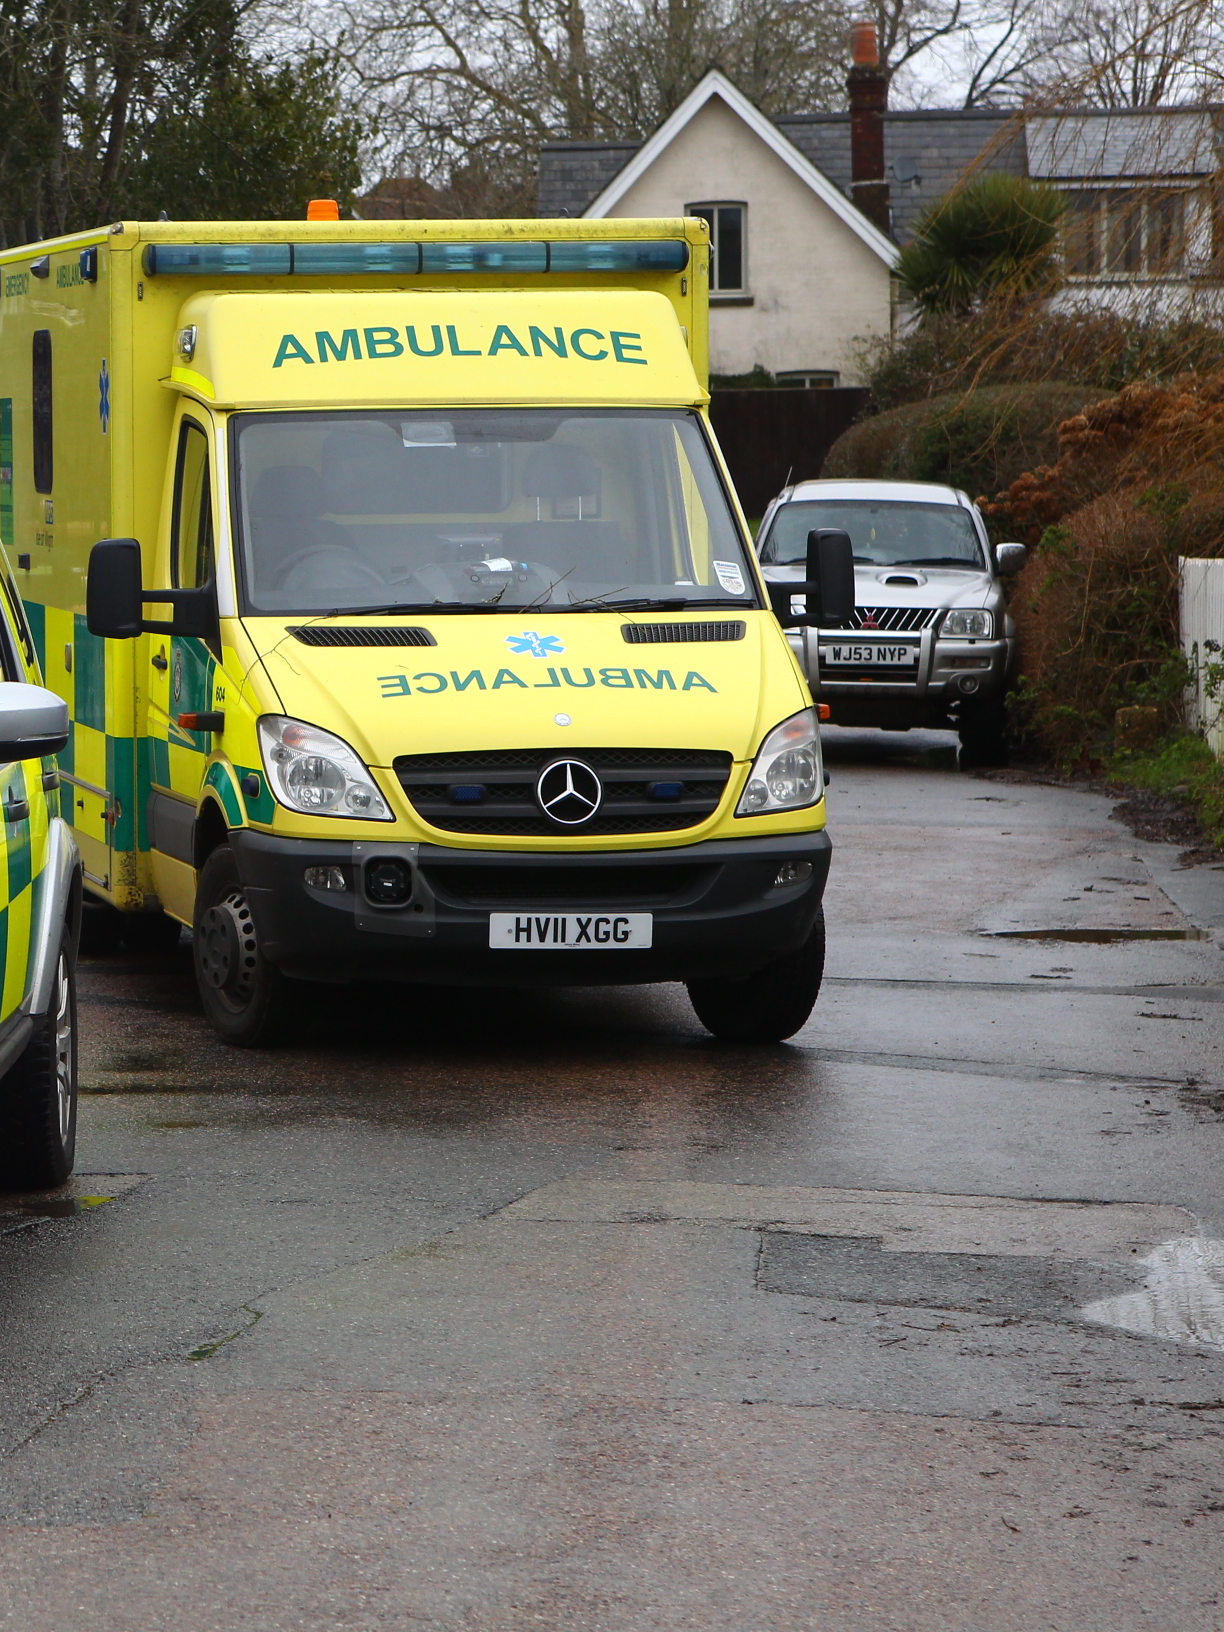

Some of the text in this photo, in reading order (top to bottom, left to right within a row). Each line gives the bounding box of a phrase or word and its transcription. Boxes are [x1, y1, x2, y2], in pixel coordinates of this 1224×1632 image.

[272, 325, 649, 368] AMBULANCE
[832, 646, 907, 661] WJ53 NYP
[515, 917, 629, 943] HV11 XGG
